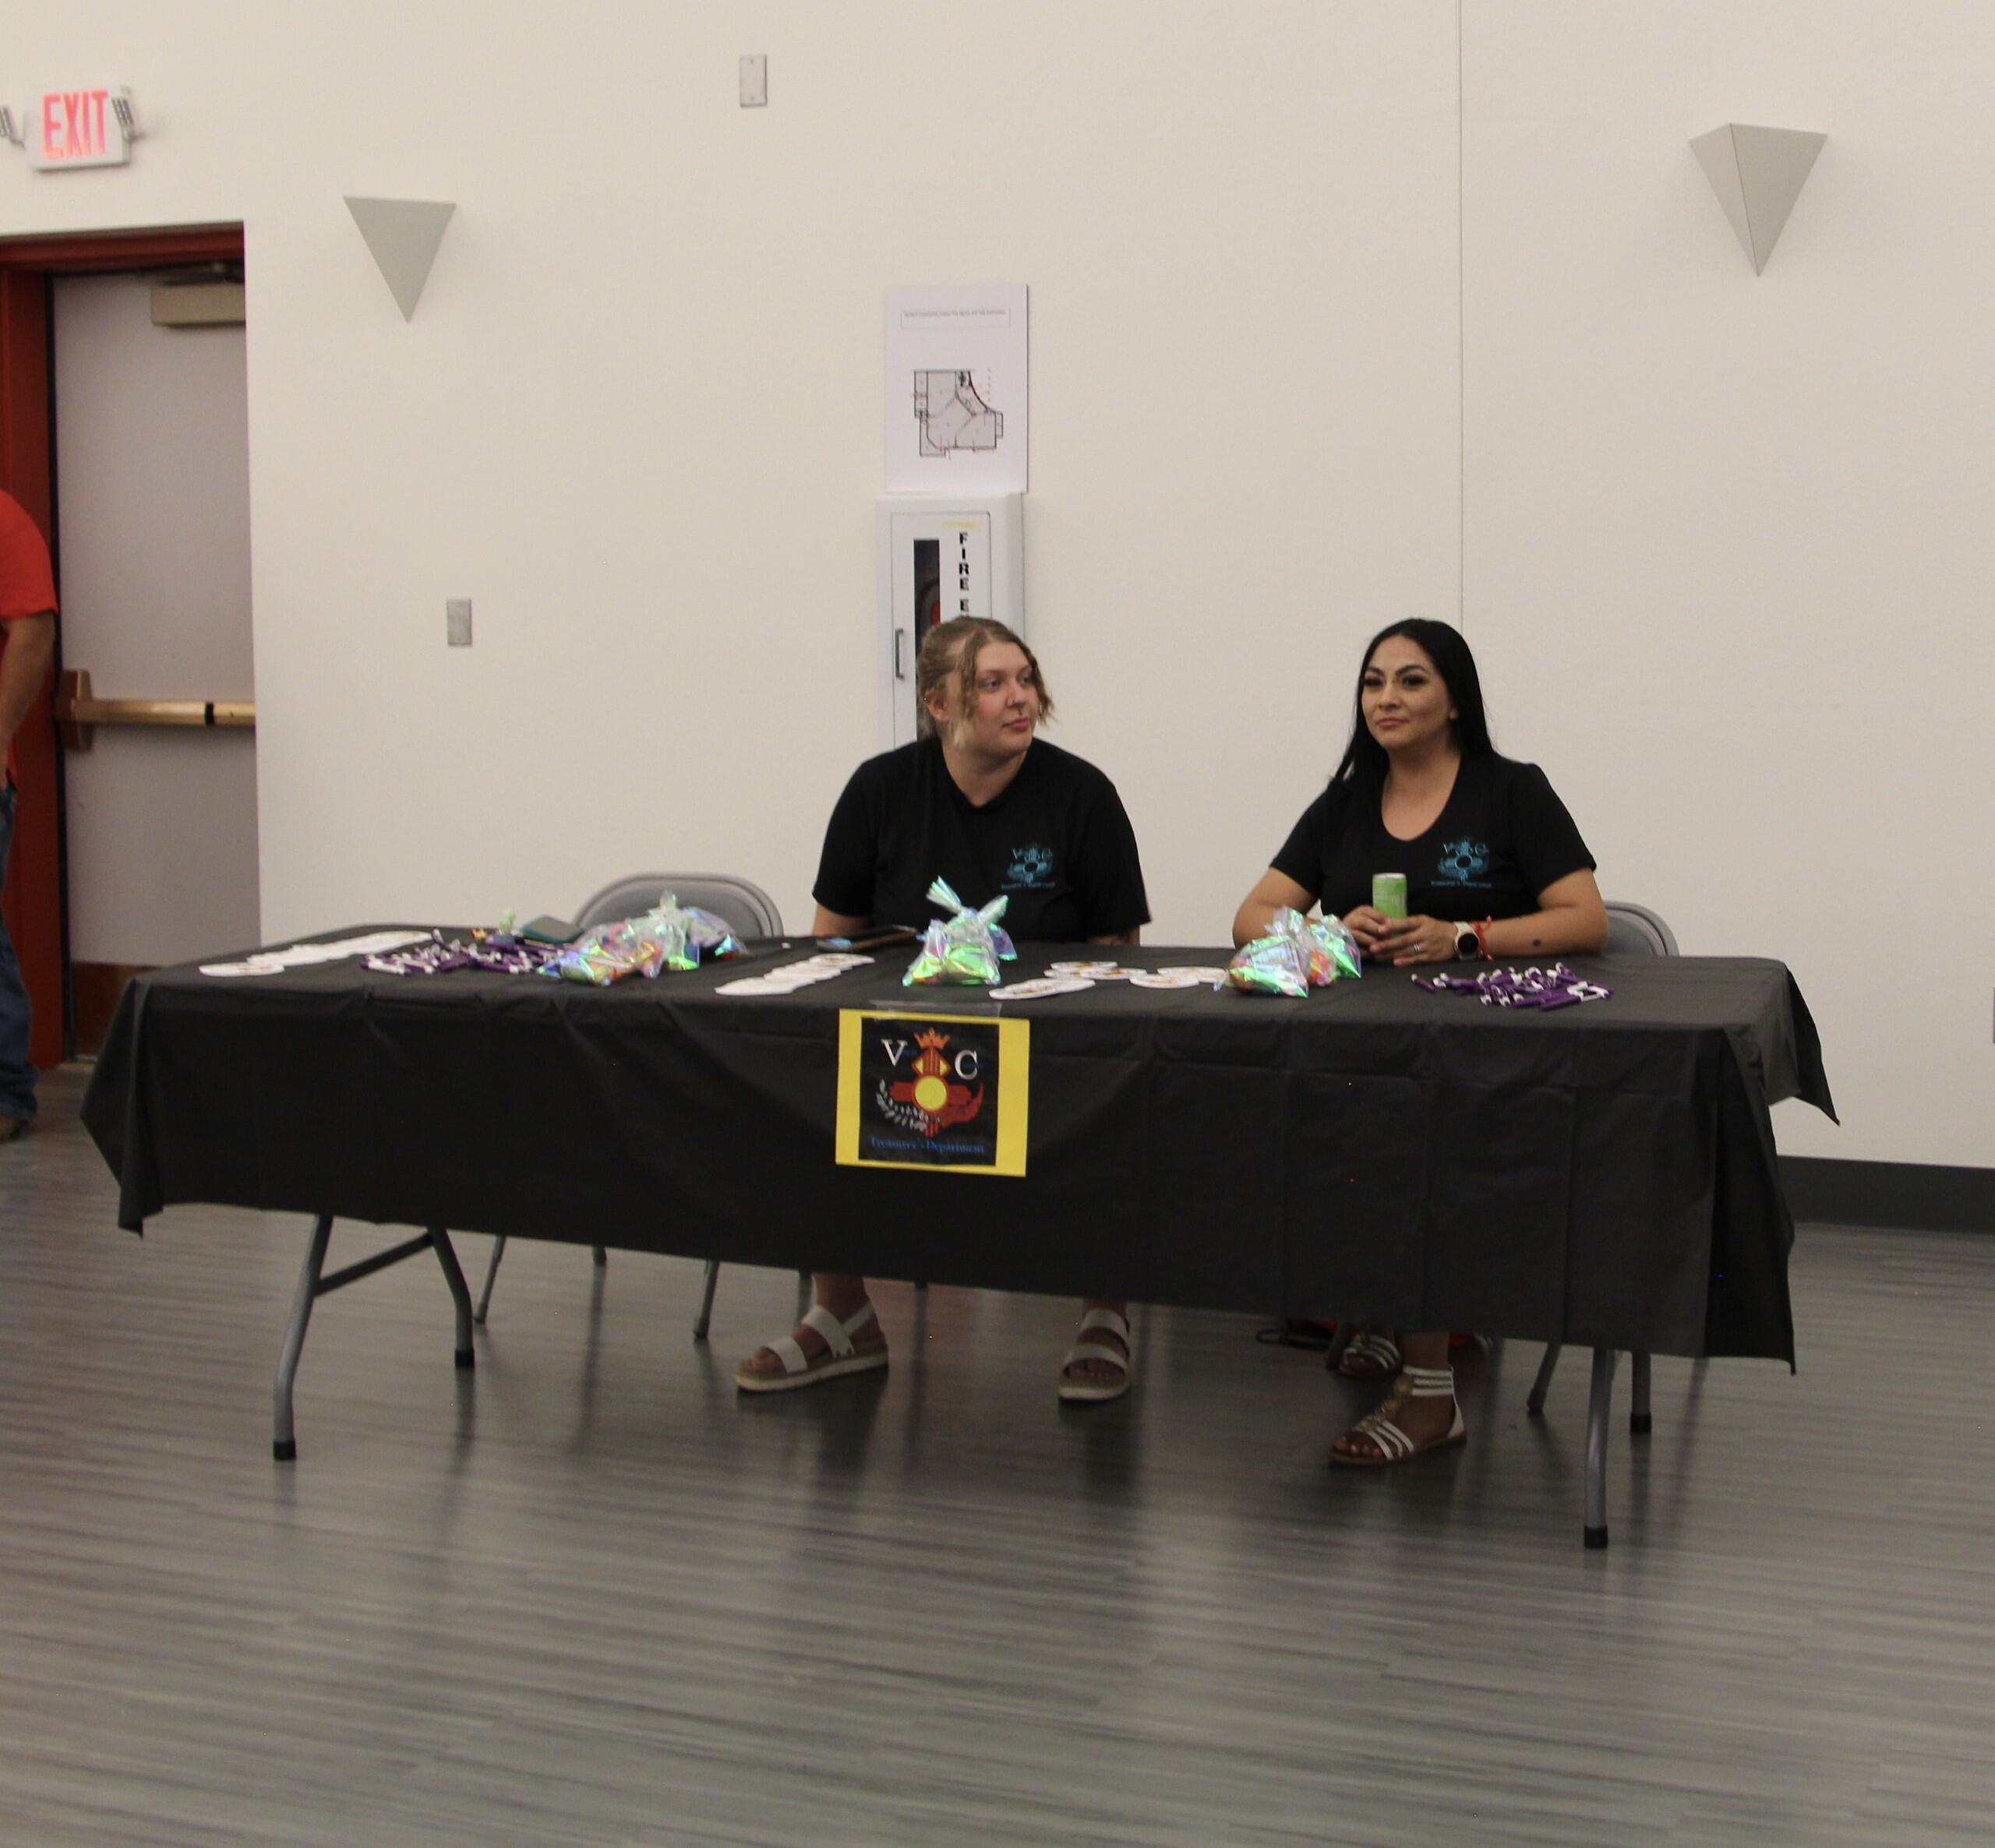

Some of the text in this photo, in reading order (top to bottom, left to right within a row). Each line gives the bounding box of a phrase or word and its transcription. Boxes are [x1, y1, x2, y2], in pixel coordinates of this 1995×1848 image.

[43, 89, 109, 159] EXIT
[959, 531, 969, 591] FIRE
[881, 1039, 978, 1080] V C
[926, 1138, 985, 1154] Department
